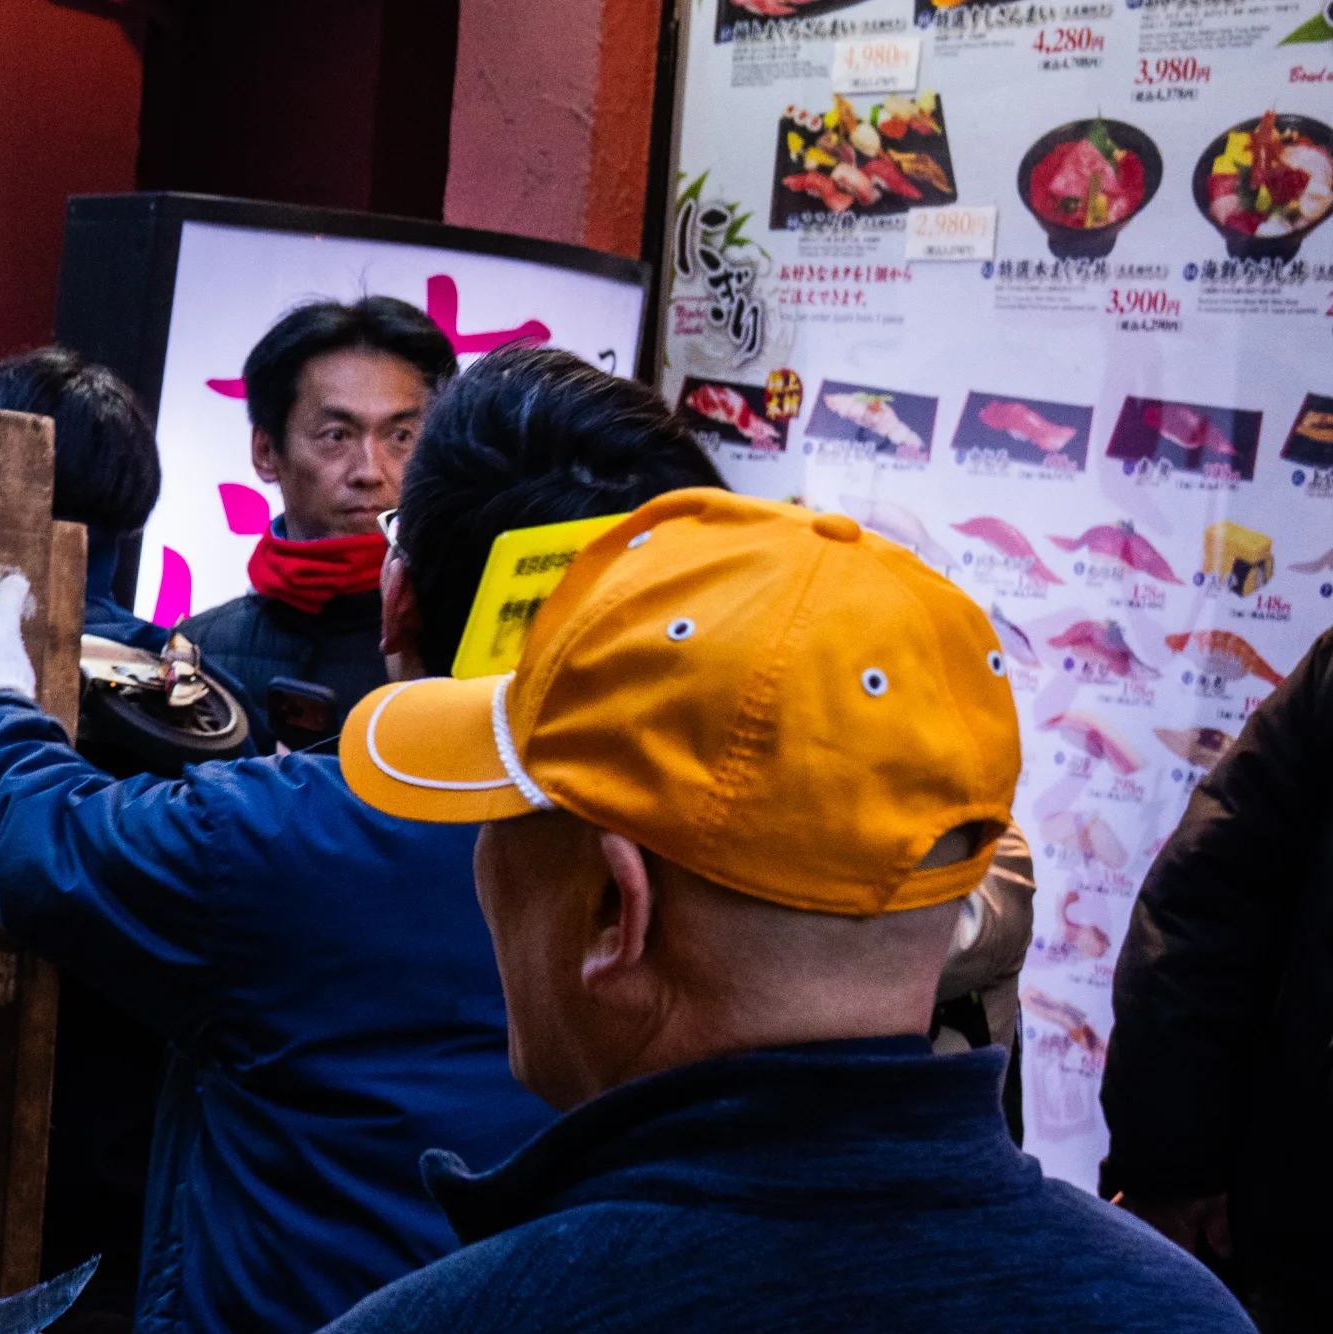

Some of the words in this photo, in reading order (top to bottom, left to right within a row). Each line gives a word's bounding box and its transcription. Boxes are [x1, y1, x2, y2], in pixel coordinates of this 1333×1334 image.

[1033, 27, 1105, 54] 4,280円
[1134, 56, 1211, 85] 3,980円
[1105, 288, 1180, 316] 3,900円
